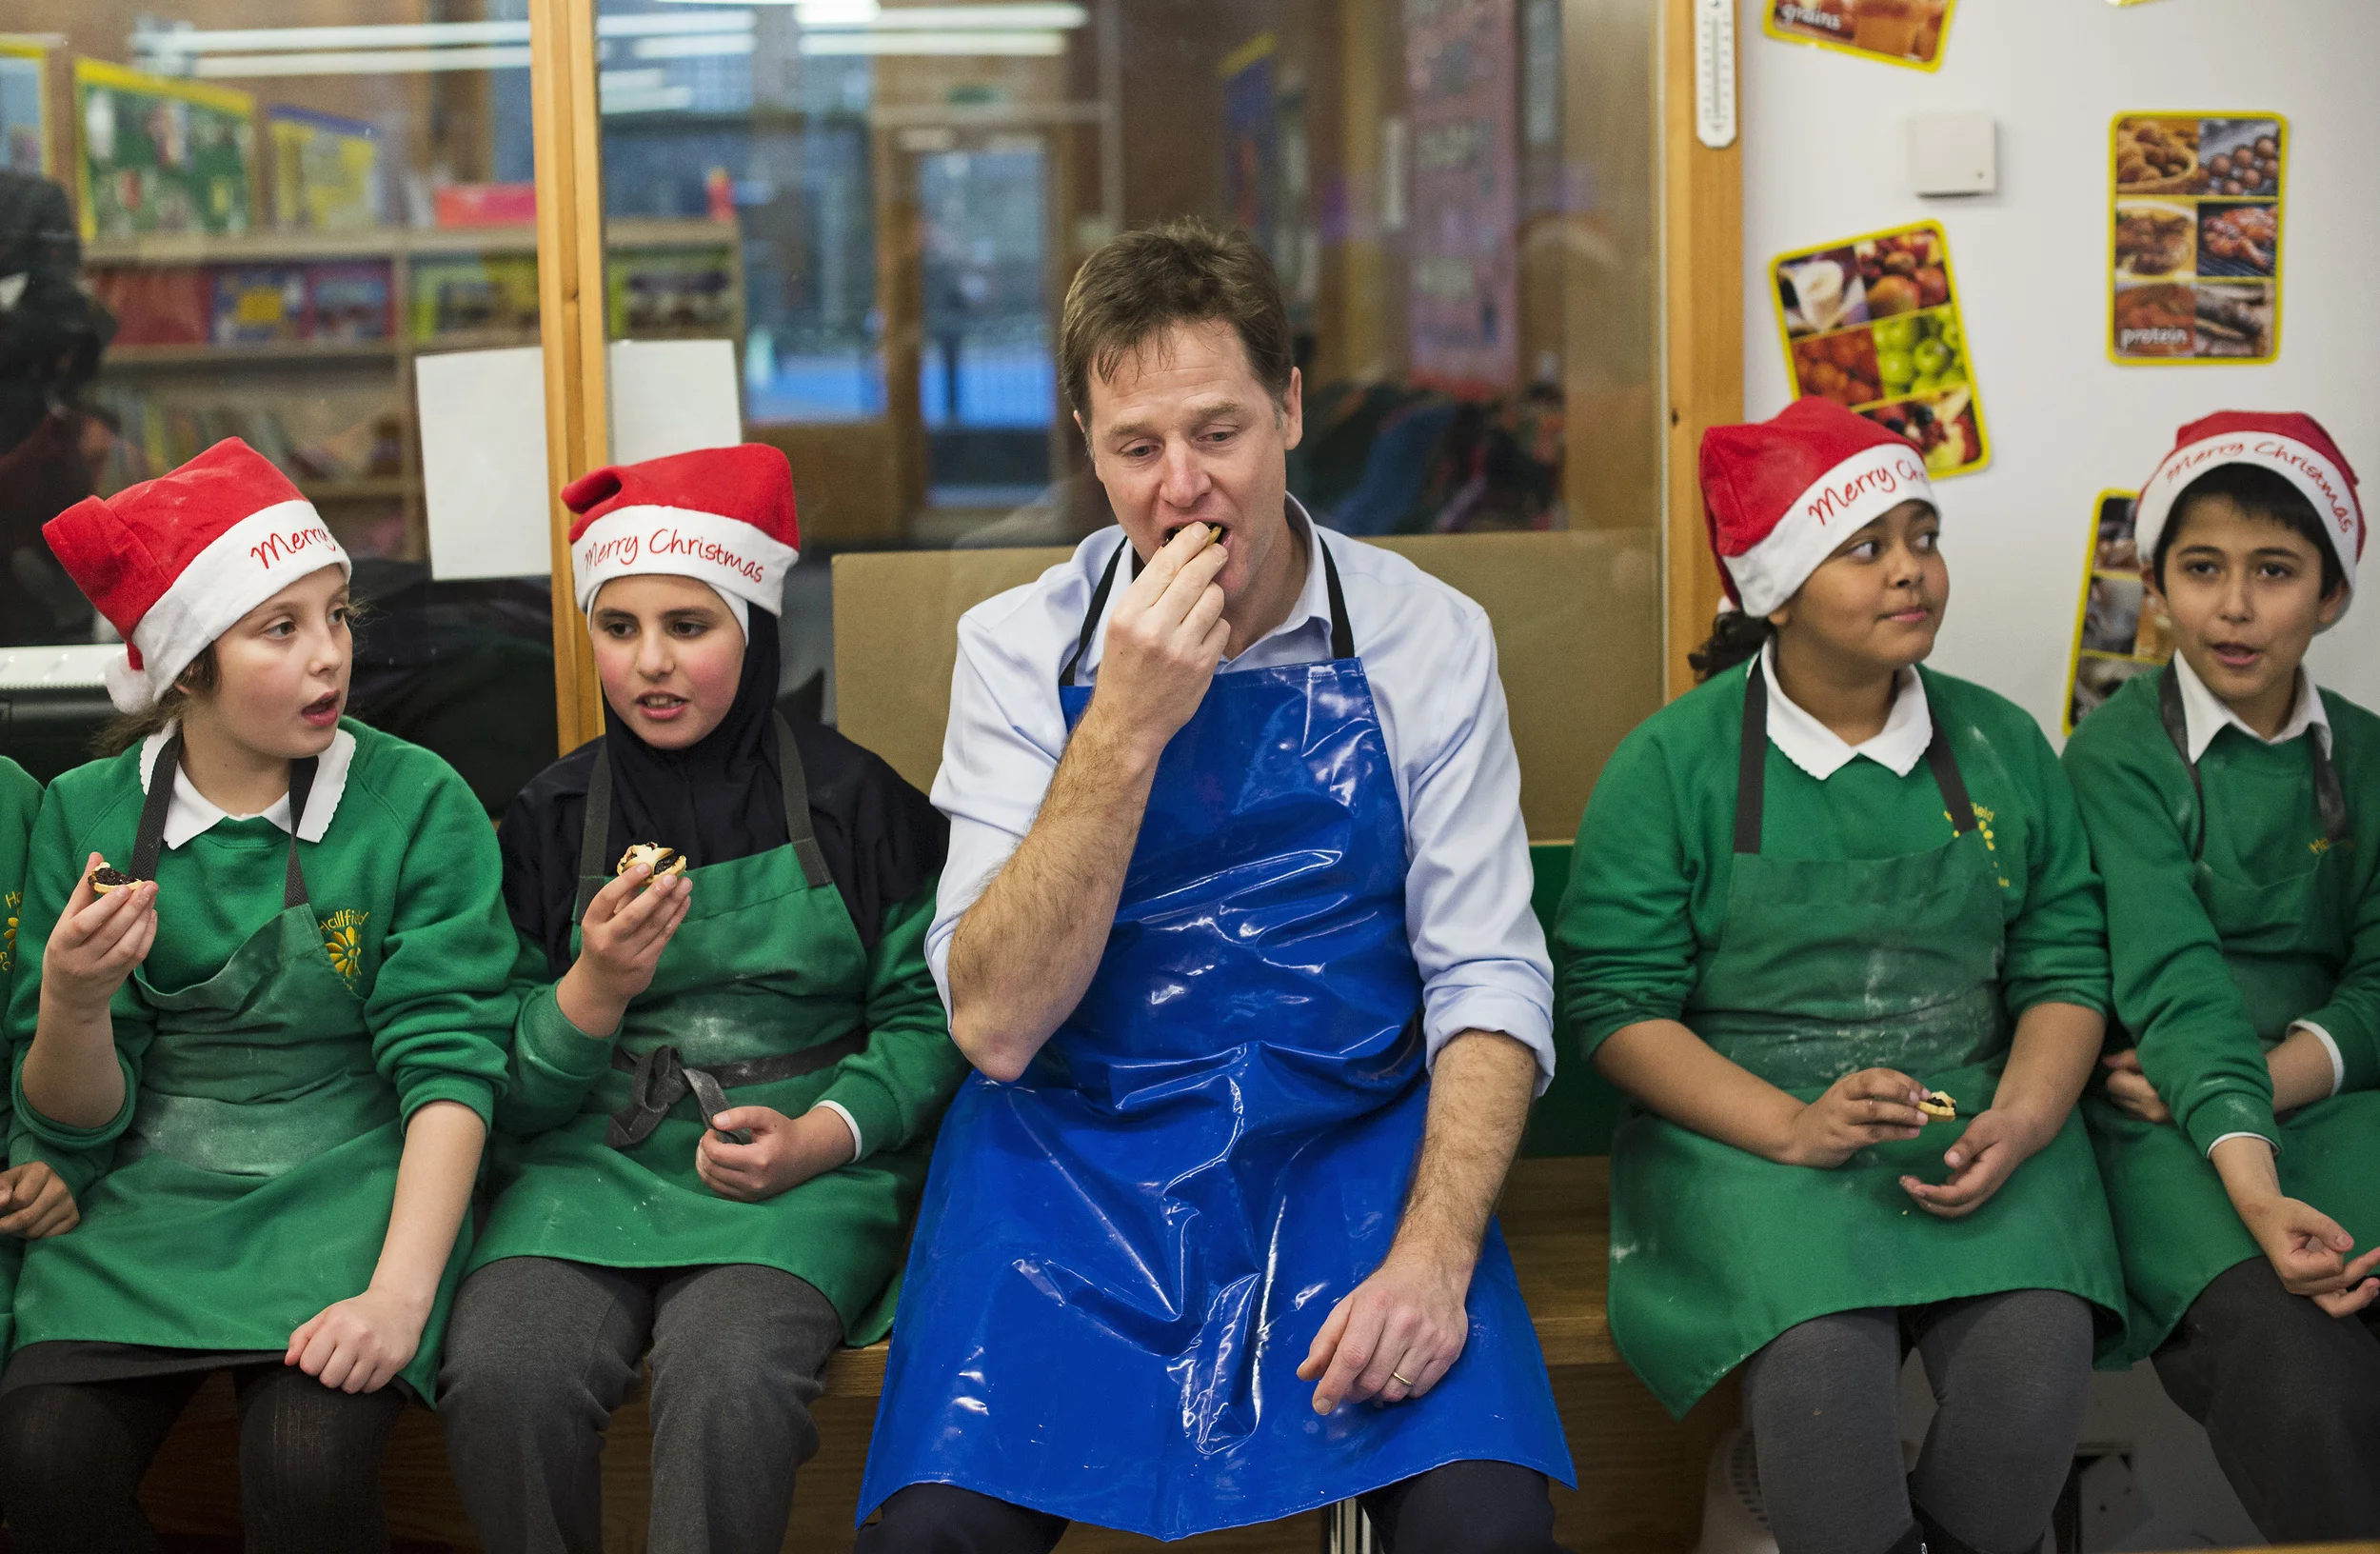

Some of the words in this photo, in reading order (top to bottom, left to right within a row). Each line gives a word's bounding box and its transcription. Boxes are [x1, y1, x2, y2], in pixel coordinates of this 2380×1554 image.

[1780, 3, 1842, 31] grains
[2120, 328, 2188, 352] protein
[1808, 466, 1896, 527] Merry
[2165, 441, 2245, 485] Merry
[2253, 441, 2354, 534] Christmas
[250, 528, 337, 569] Merry
[585, 535, 639, 572] Merry
[649, 528, 765, 584] Christmas
